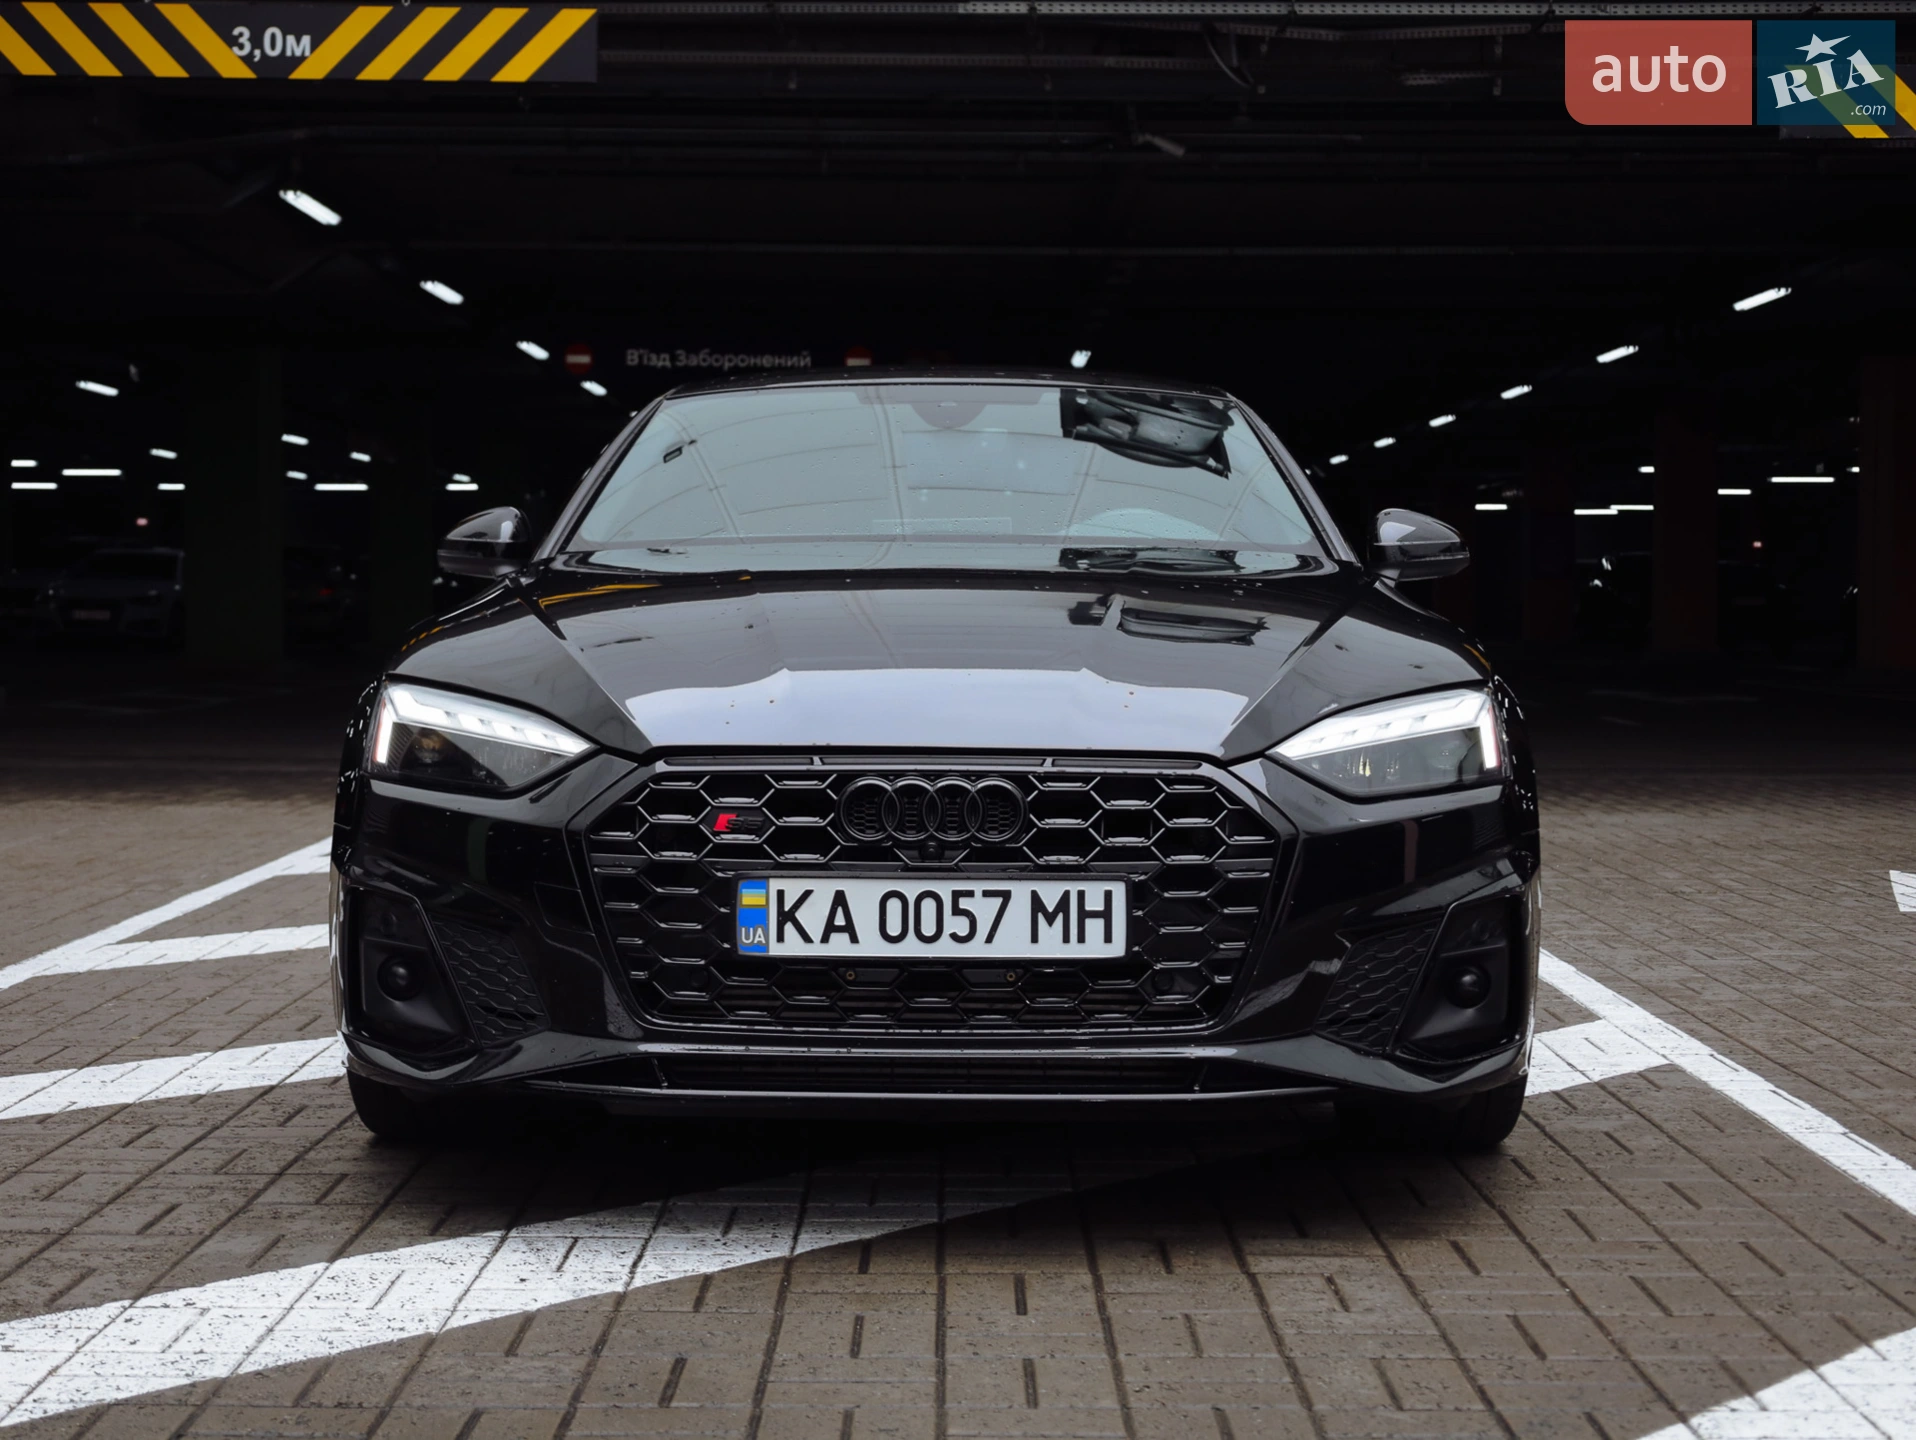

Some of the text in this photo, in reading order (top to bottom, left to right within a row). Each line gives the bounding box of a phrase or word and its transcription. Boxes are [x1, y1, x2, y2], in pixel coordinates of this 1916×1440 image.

[675, 348, 812, 371] Заборонений
[775, 888, 1113, 944] KA 0057 MH
[740, 927, 766, 944] UA
